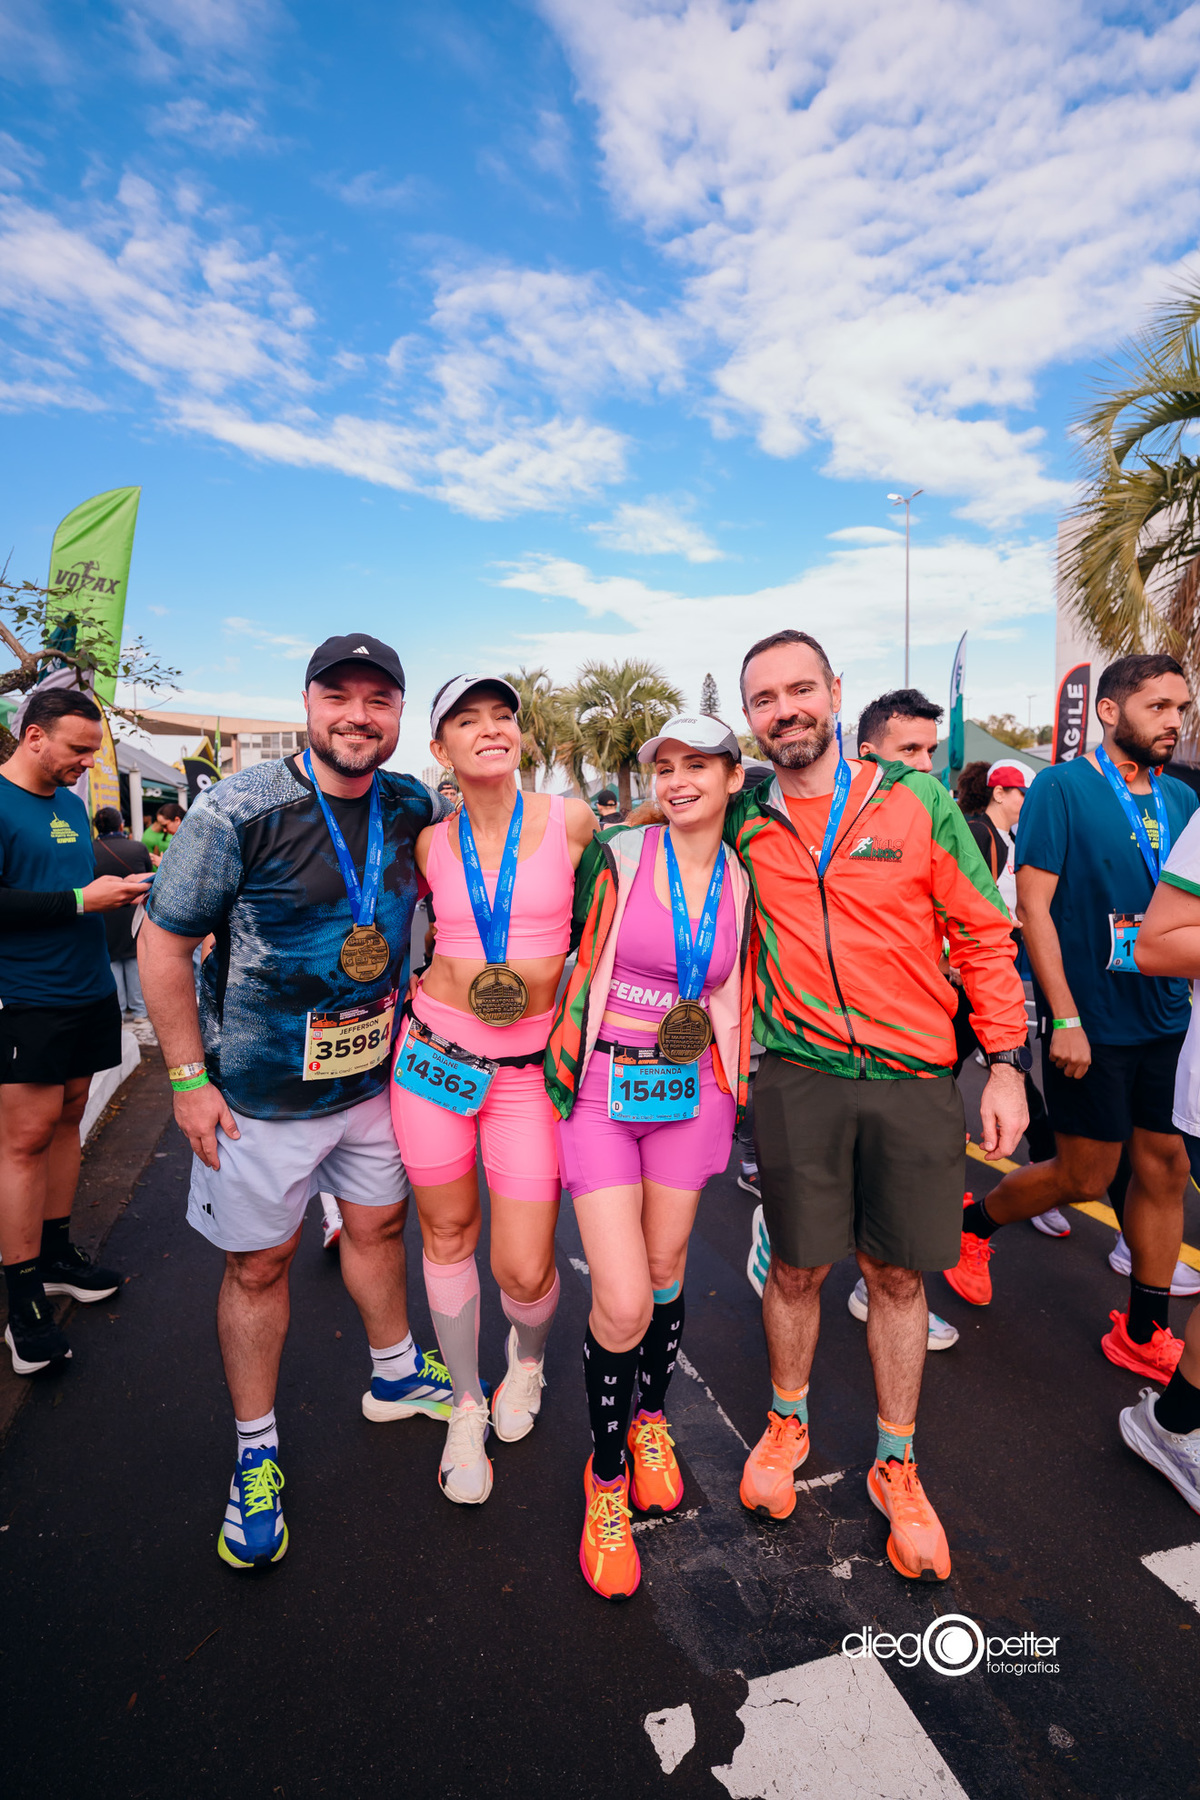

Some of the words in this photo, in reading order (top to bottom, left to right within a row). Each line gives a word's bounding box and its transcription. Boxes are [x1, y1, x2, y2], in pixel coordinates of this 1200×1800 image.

[1061, 683, 1084, 762] AGILE
[1122, 940, 1136, 957] 1
[340, 1019, 379, 1036] JEFFERSON
[315, 1022, 390, 1060] 35984
[312, 1062, 318, 1070] E
[432, 1053, 459, 1069] DAIANE
[396, 1067, 402, 1077] C
[406, 1053, 477, 1100] 14362
[620, 1077, 695, 1102] 15498
[615, 1103, 620, 1111] D
